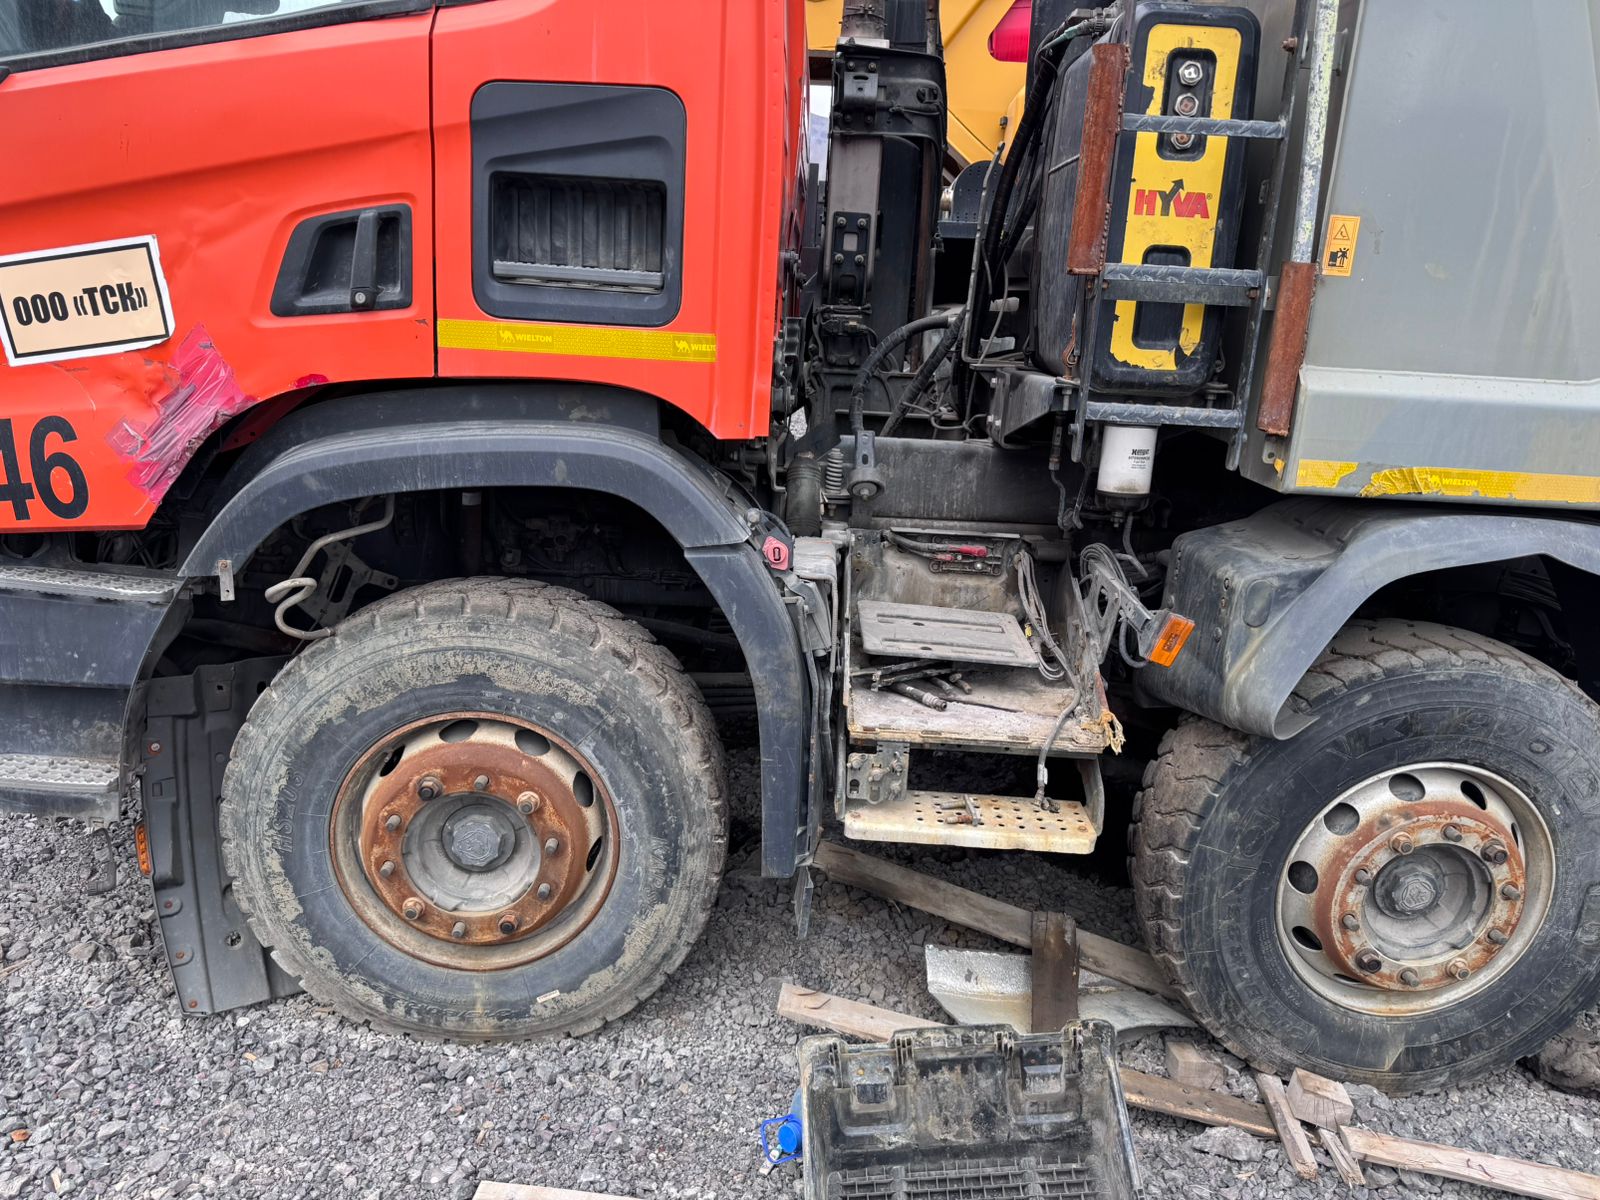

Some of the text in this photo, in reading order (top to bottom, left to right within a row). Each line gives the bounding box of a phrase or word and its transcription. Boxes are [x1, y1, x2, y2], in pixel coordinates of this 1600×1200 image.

[1134, 178, 1210, 219] HYVA
[515, 333, 552, 343] WIELTON
[0, 415, 89, 520] 46
[1442, 478, 1479, 487] WIELTON
